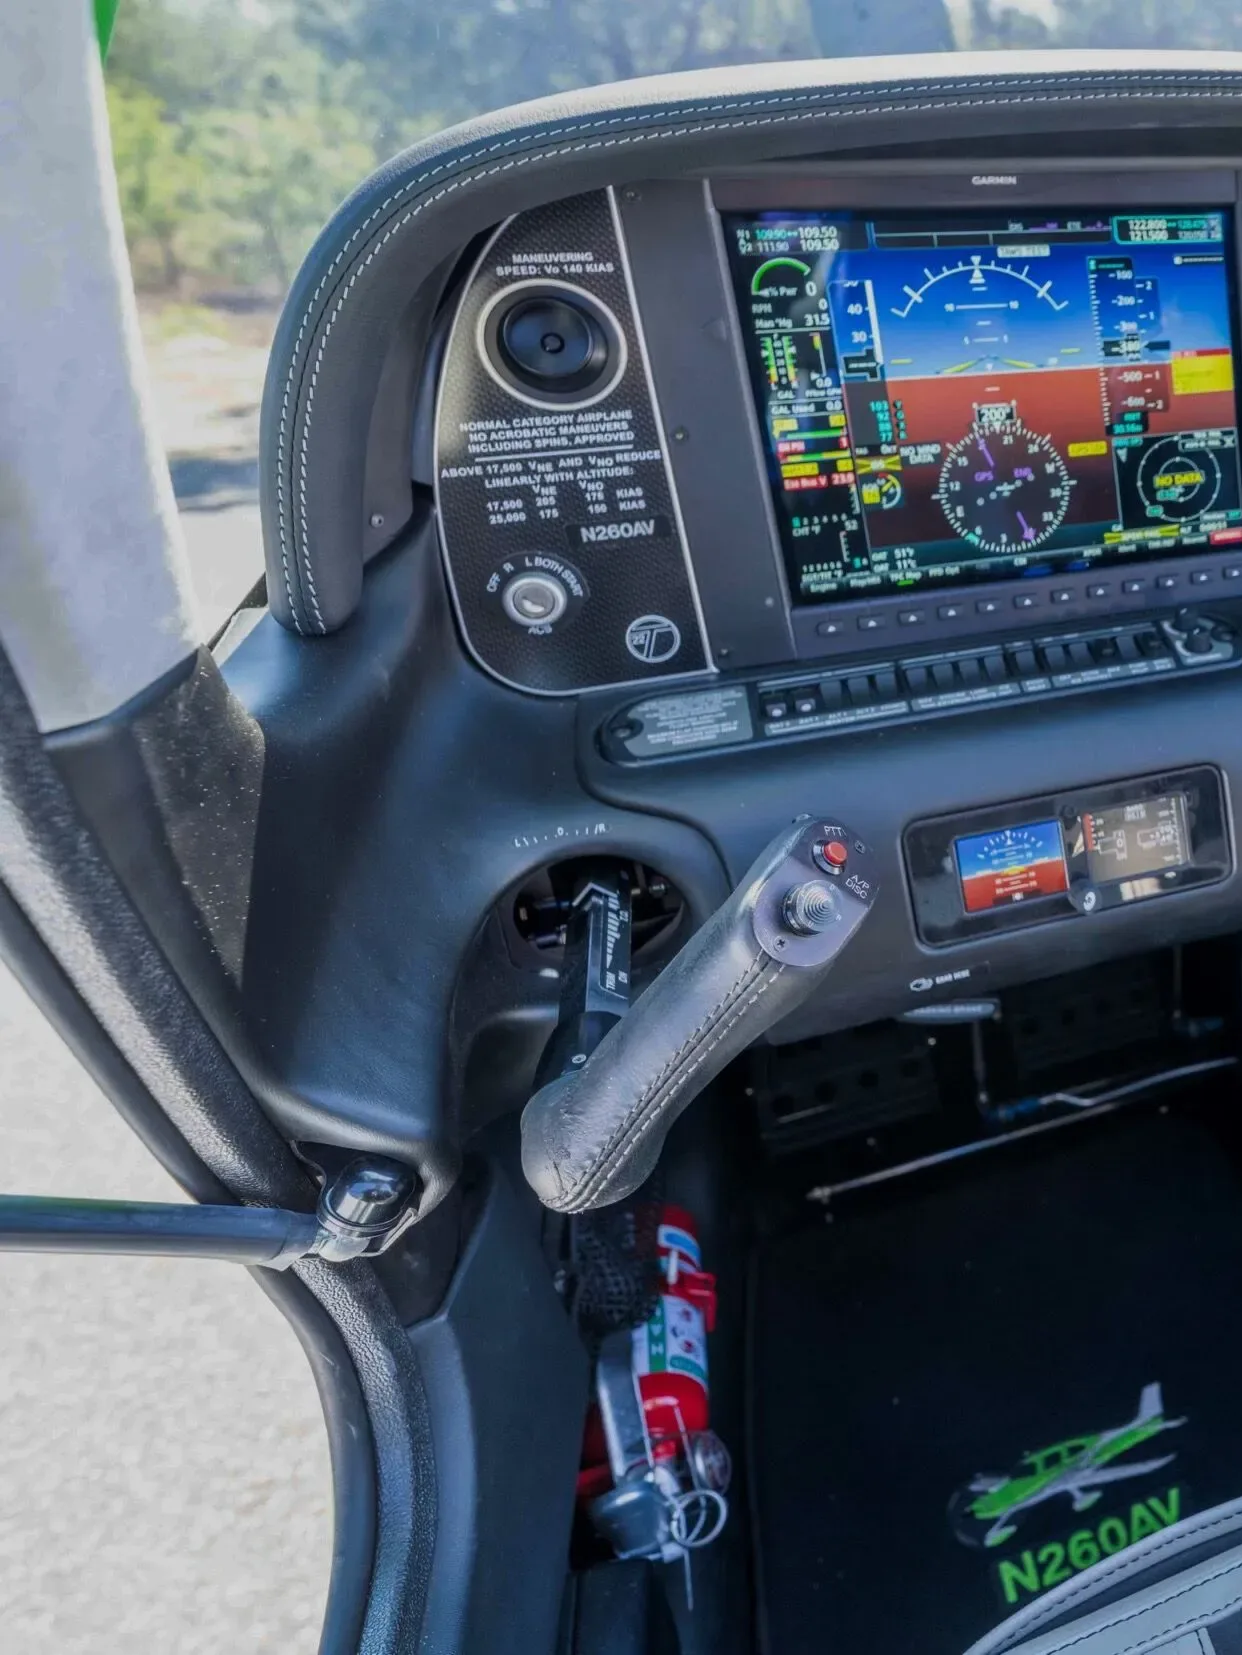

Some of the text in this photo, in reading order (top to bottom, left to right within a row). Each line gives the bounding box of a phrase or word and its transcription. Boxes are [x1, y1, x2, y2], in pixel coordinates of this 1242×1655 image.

[972, 176, 1016, 186] GARMIN
[512, 252, 594, 264] MANEUVERING
[496, 265, 542, 276] SPEED:
[562, 264, 582, 274] 140
[585, 262, 614, 273] KIAS
[460, 410, 633, 433] NORMAL CATEGORY AIRPLANE
[469, 422, 629, 442] NO ACROBATIC MANEUVERS
[468, 440, 532, 454] INCLUDING
[574, 431, 635, 445] APPROVED
[440, 466, 484, 479] ABOVE
[558, 456, 584, 468] AND
[615, 450, 662, 463] REDUCE
[484, 474, 542, 489] LINEARLY
[543, 471, 574, 484] WITH
[974, 471, 994, 482] GPS
[616, 486, 644, 499] KIAS
[618, 500, 646, 512] KIAS
[580, 520, 656, 543] N260AV
[534, 556, 564, 574] BOTH
[561, 569, 584, 597] START
[824, 825, 843, 836] PTT
[846, 878, 868, 899] DISC
[851, 874, 870, 890] A/P
[998, 1488, 1180, 1603] N260AV
